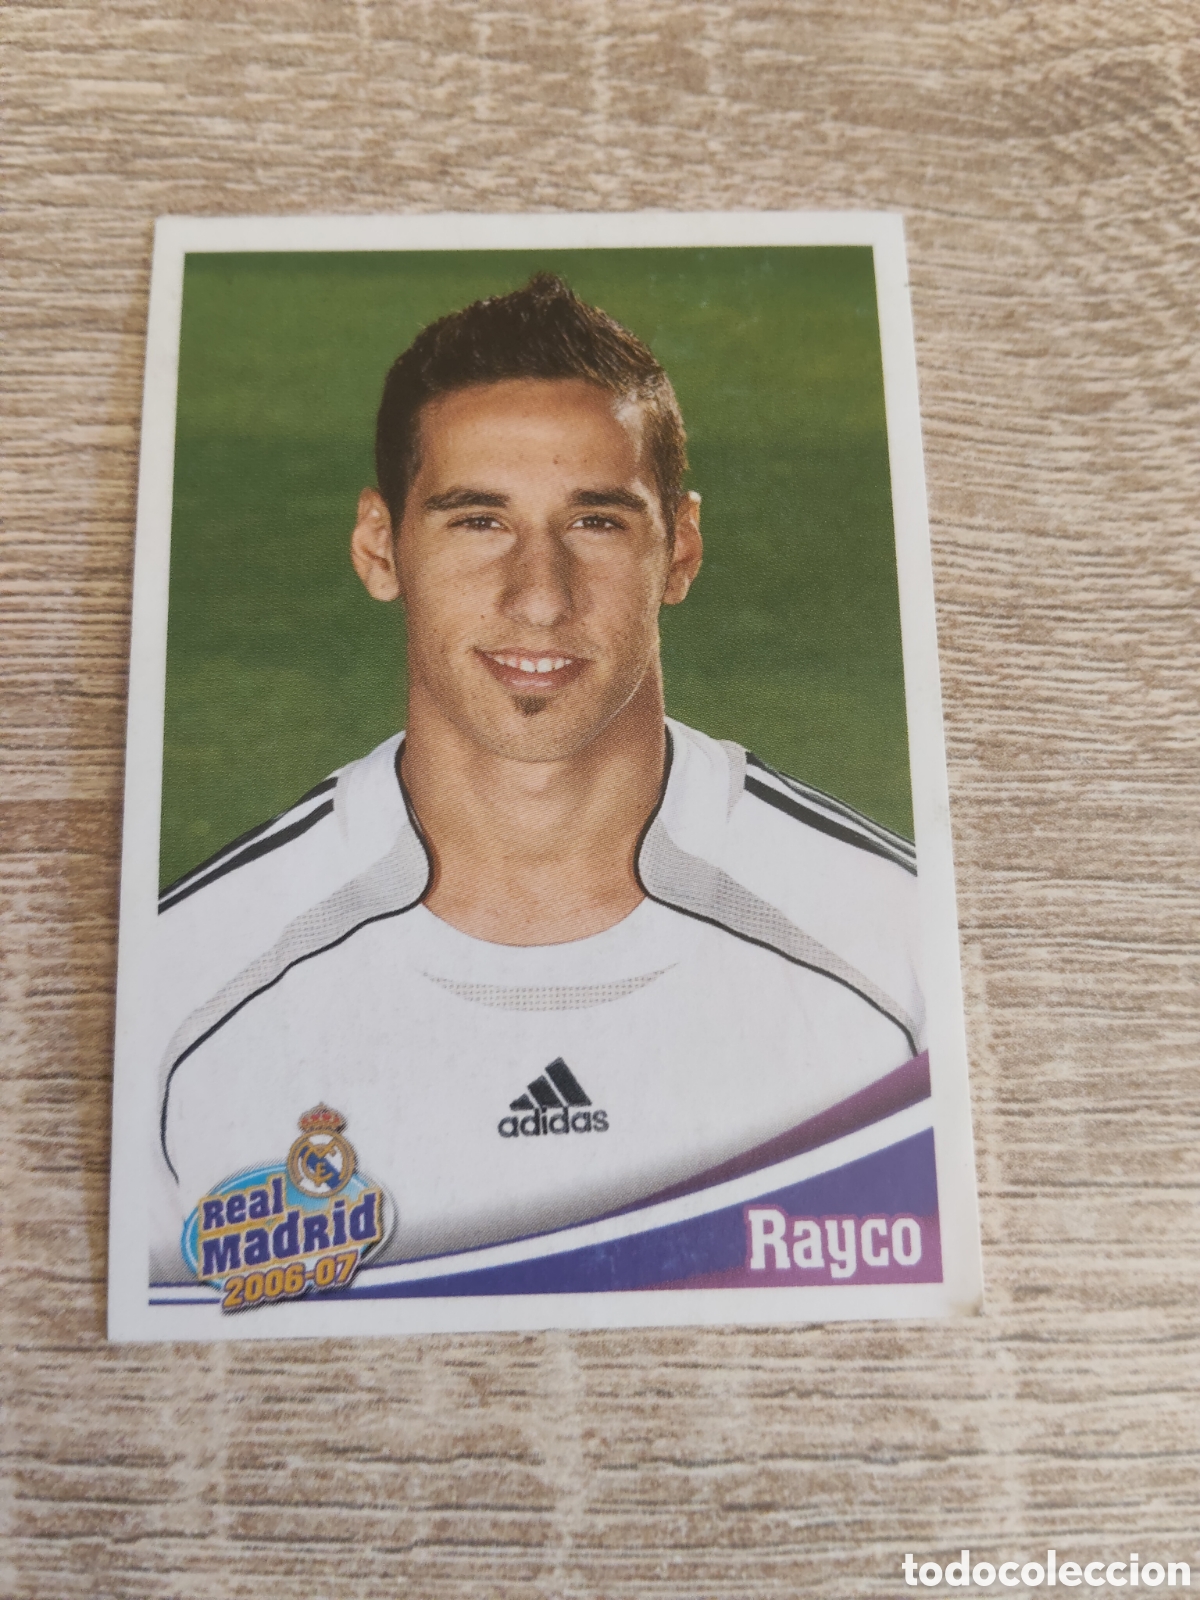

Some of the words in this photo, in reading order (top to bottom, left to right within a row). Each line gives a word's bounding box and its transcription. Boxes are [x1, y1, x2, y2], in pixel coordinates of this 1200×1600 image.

[498, 1107, 609, 1138] adidas
[203, 1177, 285, 1231] Real
[748, 1209, 922, 1278] Rayco
[222, 1252, 358, 1309] 2006-07
